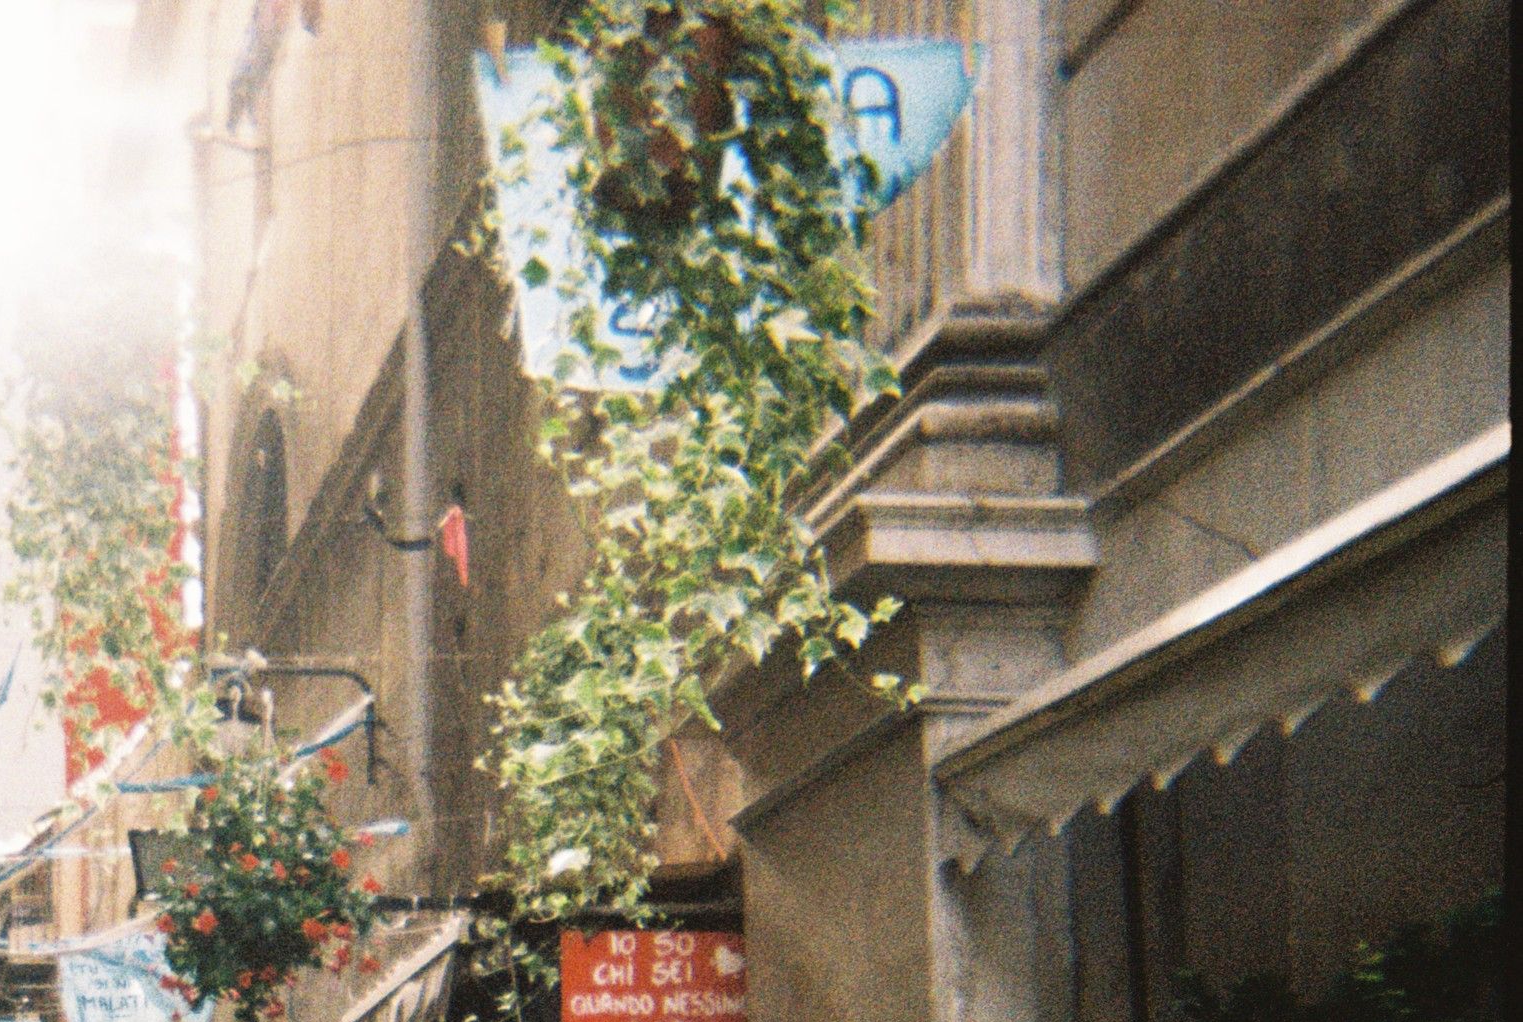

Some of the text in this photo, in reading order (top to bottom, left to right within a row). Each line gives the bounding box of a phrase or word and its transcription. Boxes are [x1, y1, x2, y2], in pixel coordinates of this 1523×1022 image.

[652, 931, 695, 957] SO
[592, 960, 694, 987] CHI SEI
[569, 990, 655, 1016] QUANDO
